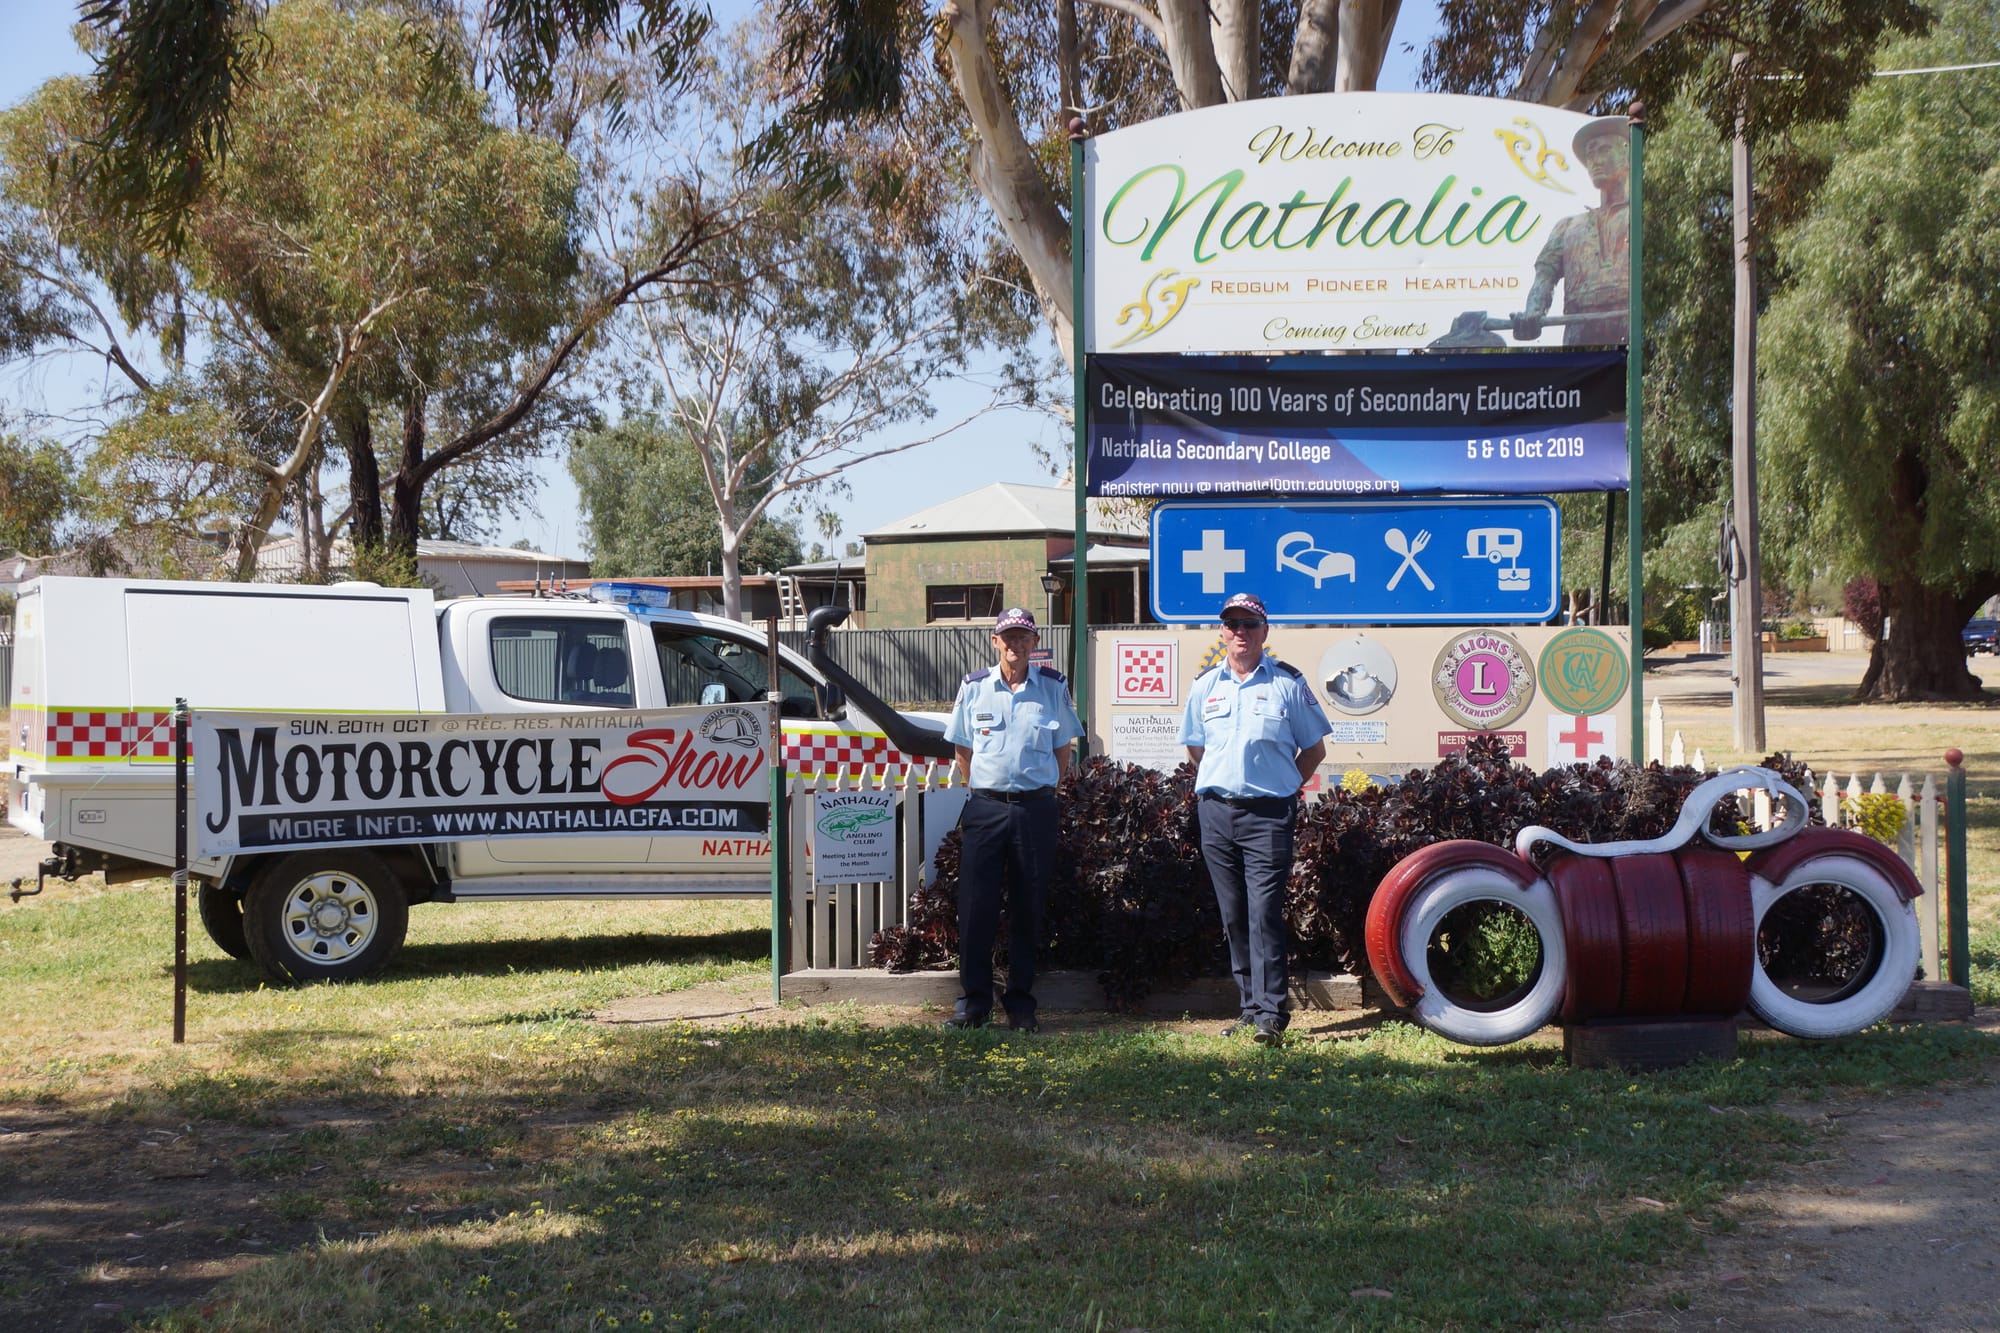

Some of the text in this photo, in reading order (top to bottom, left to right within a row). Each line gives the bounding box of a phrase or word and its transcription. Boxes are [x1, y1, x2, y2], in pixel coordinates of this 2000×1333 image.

[1248, 123, 1464, 163] Welcome To
[1102, 163, 1542, 263] Nathalia
[1262, 315, 1429, 343] Coming Events
[1101, 382, 1581, 416] Celebrating 100 Years of Secondary Education
[1102, 437, 1331, 463] Nathalia Secondary College
[1467, 437, 1584, 458] 5 & 6 Oct 2019
[1101, 480, 1160, 497] Register
[1162, 481, 1193, 495] now
[1196, 481, 1211, 493] @
[1458, 635, 1510, 655] LIONS
[1124, 677, 1165, 693] CFA
[1470, 661, 1497, 694] L
[1454, 699, 1512, 718] INTERNATIONAL
[291, 719, 333, 735] SUN.
[338, 719, 384, 734] 20TH
[393, 719, 430, 732] OCT
[442, 719, 459, 732] @
[561, 715, 644, 729] NATHALIA
[700, 707, 760, 732] NATHALIA FIRE BRIGADE
[1128, 717, 1172, 726] NATHALIA
[1114, 726, 1145, 734] YOUNG
[1439, 735, 1466, 745] MEETS
[206, 727, 765, 834] MOTORCYCLE Show
[821, 796, 890, 810] NATHALIA
[268, 807, 738, 840] MORE INFO: WWW.NATHALIACFA.COM
[845, 831, 882, 839] ANGLING
[702, 839, 811, 857] NATHA
